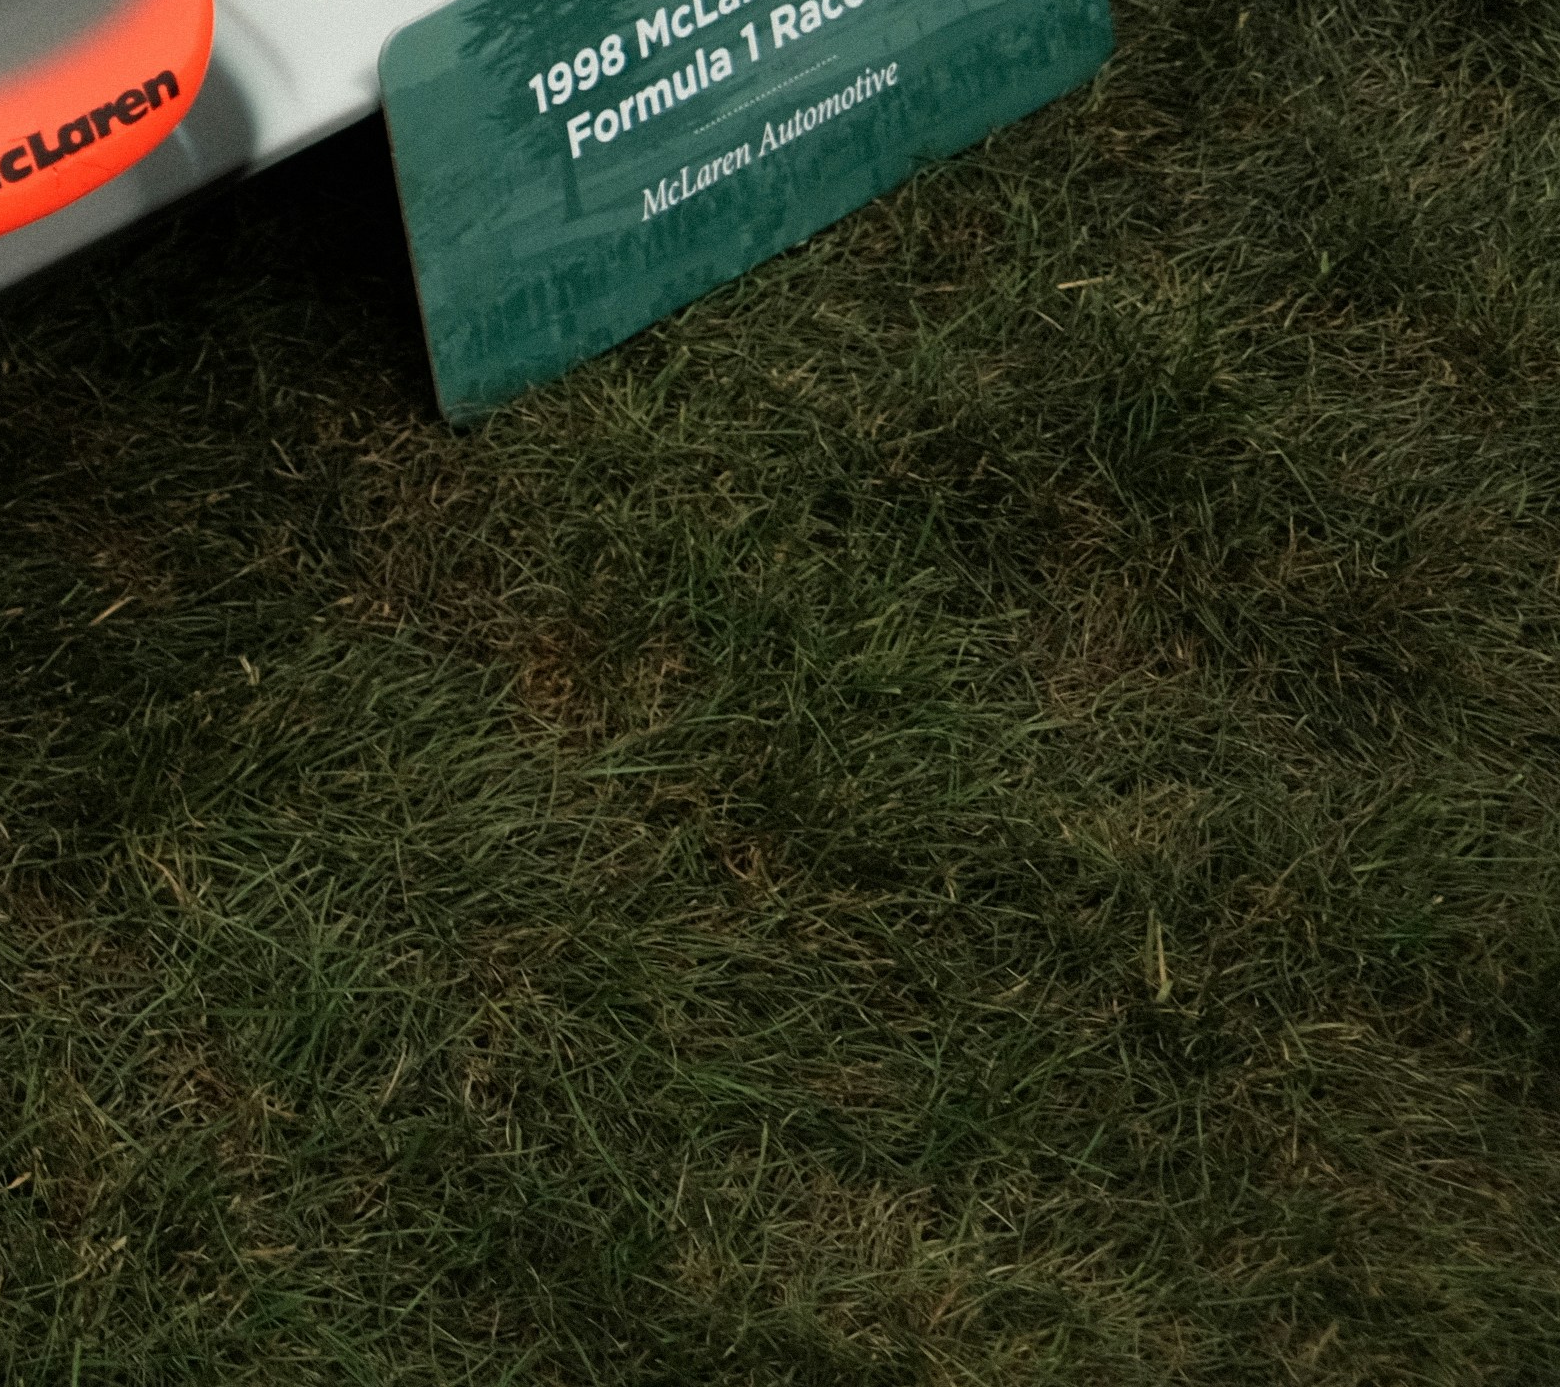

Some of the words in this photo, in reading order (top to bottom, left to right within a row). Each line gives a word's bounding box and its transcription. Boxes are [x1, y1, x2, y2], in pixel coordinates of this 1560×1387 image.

[528, 33, 627, 115] 1998
[566, 47, 734, 160] Formula
[740, 21, 760, 63] 1
[640, 141, 752, 223] McLaren
[757, 60, 899, 158] Automotive
